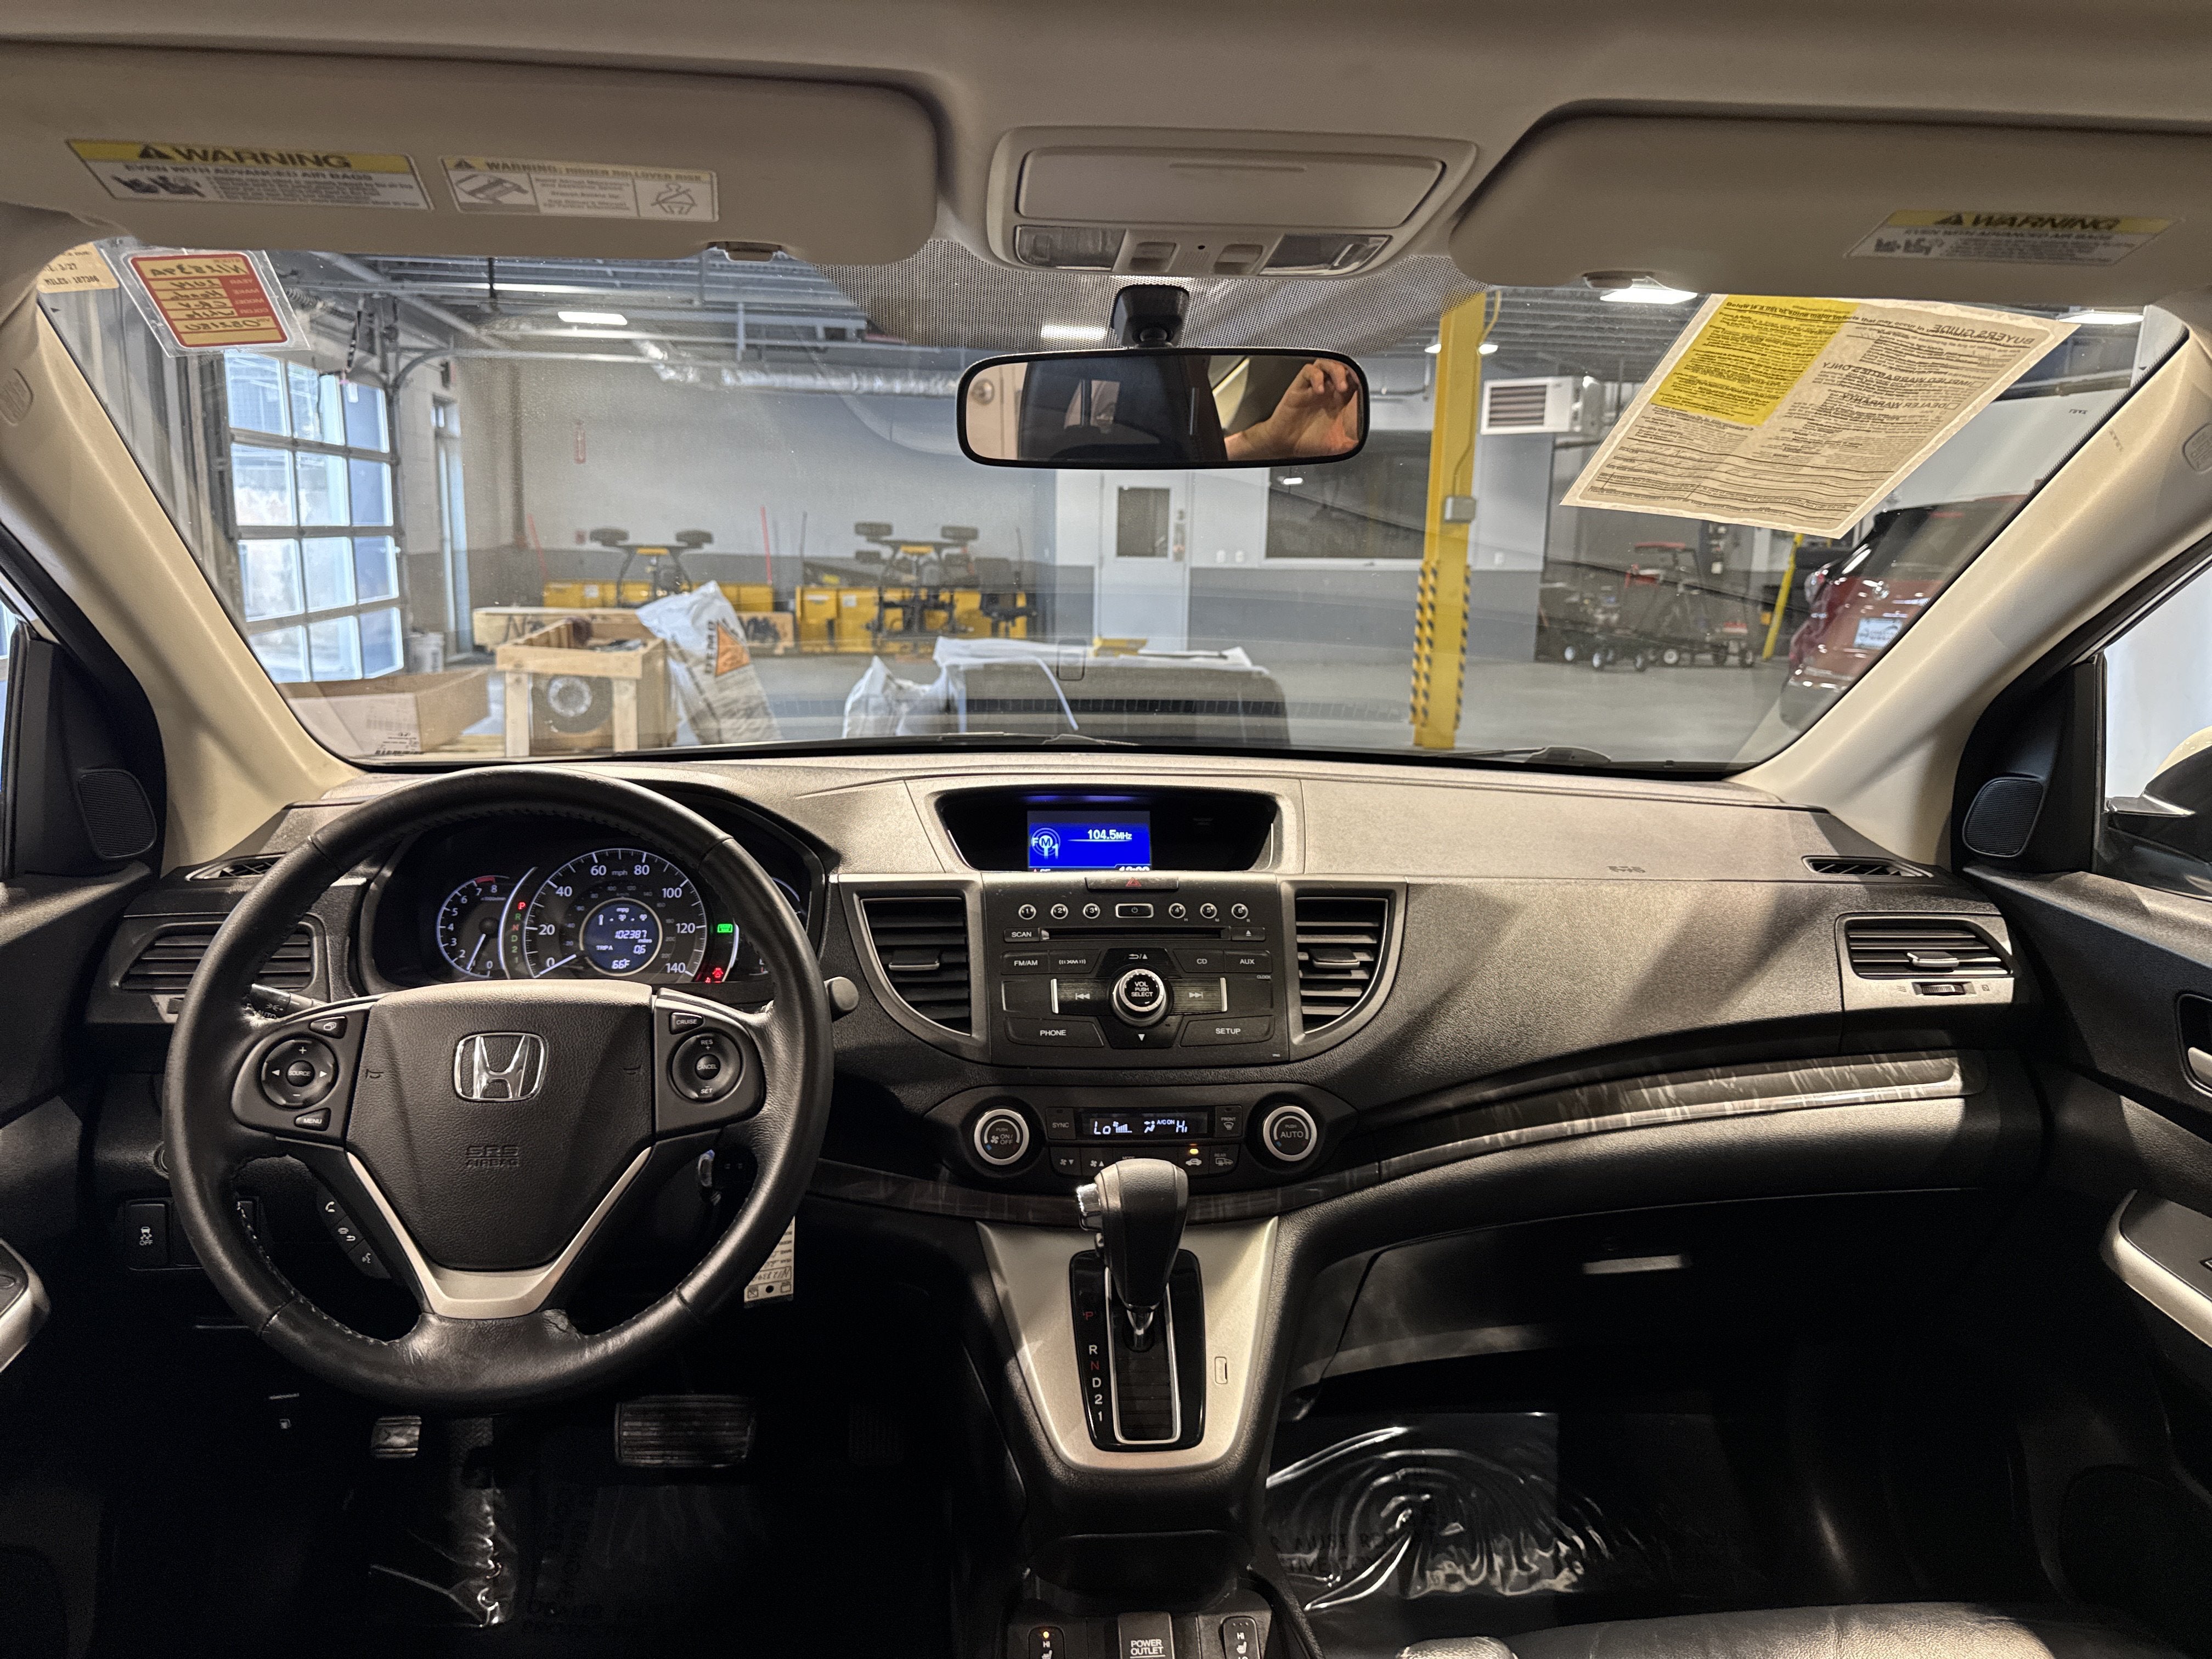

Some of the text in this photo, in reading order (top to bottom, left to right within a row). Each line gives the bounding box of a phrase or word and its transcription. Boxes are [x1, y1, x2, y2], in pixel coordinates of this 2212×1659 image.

[172, 146, 352, 168] WARNING
[1972, 214, 2120, 230] WARNING
[1087, 829, 1132, 840] 104.5MHz
[590, 865, 607, 876] 60
[634, 865, 650, 876] 80
[476, 888, 482, 896] 7
[491, 884, 498, 893] 8
[555, 886, 573, 897] 40
[662, 887, 682, 899] 100
[461, 895, 468, 904] 6
[518, 901, 526, 910] P
[451, 908, 458, 916] 5
[447, 923, 454, 932] 4
[539, 924, 556, 935] 20
[676, 923, 696, 934] 120
[614, 930, 647, 939] 102387
[450, 938, 458, 946] 3
[459, 950, 466, 958] 2
[487, 961, 493, 969] 0
[546, 957, 555, 968] 0
[665, 962, 686, 973] 140
[1215, 1027, 1241, 1035] SETUP
[1280, 1131, 1304, 1139] AUTO
[466, 1145, 518, 1156] SRS
[465, 1158, 518, 1167] AIRBAG
[1084, 1311, 1093, 1321] P
[1088, 1345, 1098, 1355] R
[1090, 1361, 1099, 1370] N
[1092, 1378, 1101, 1388] D
[1094, 1394, 1103, 1404] 2
[1098, 1411, 1103, 1421] 1
[1130, 1639, 1163, 1648] POWER
[1130, 1646, 1164, 1656] OUTLET
